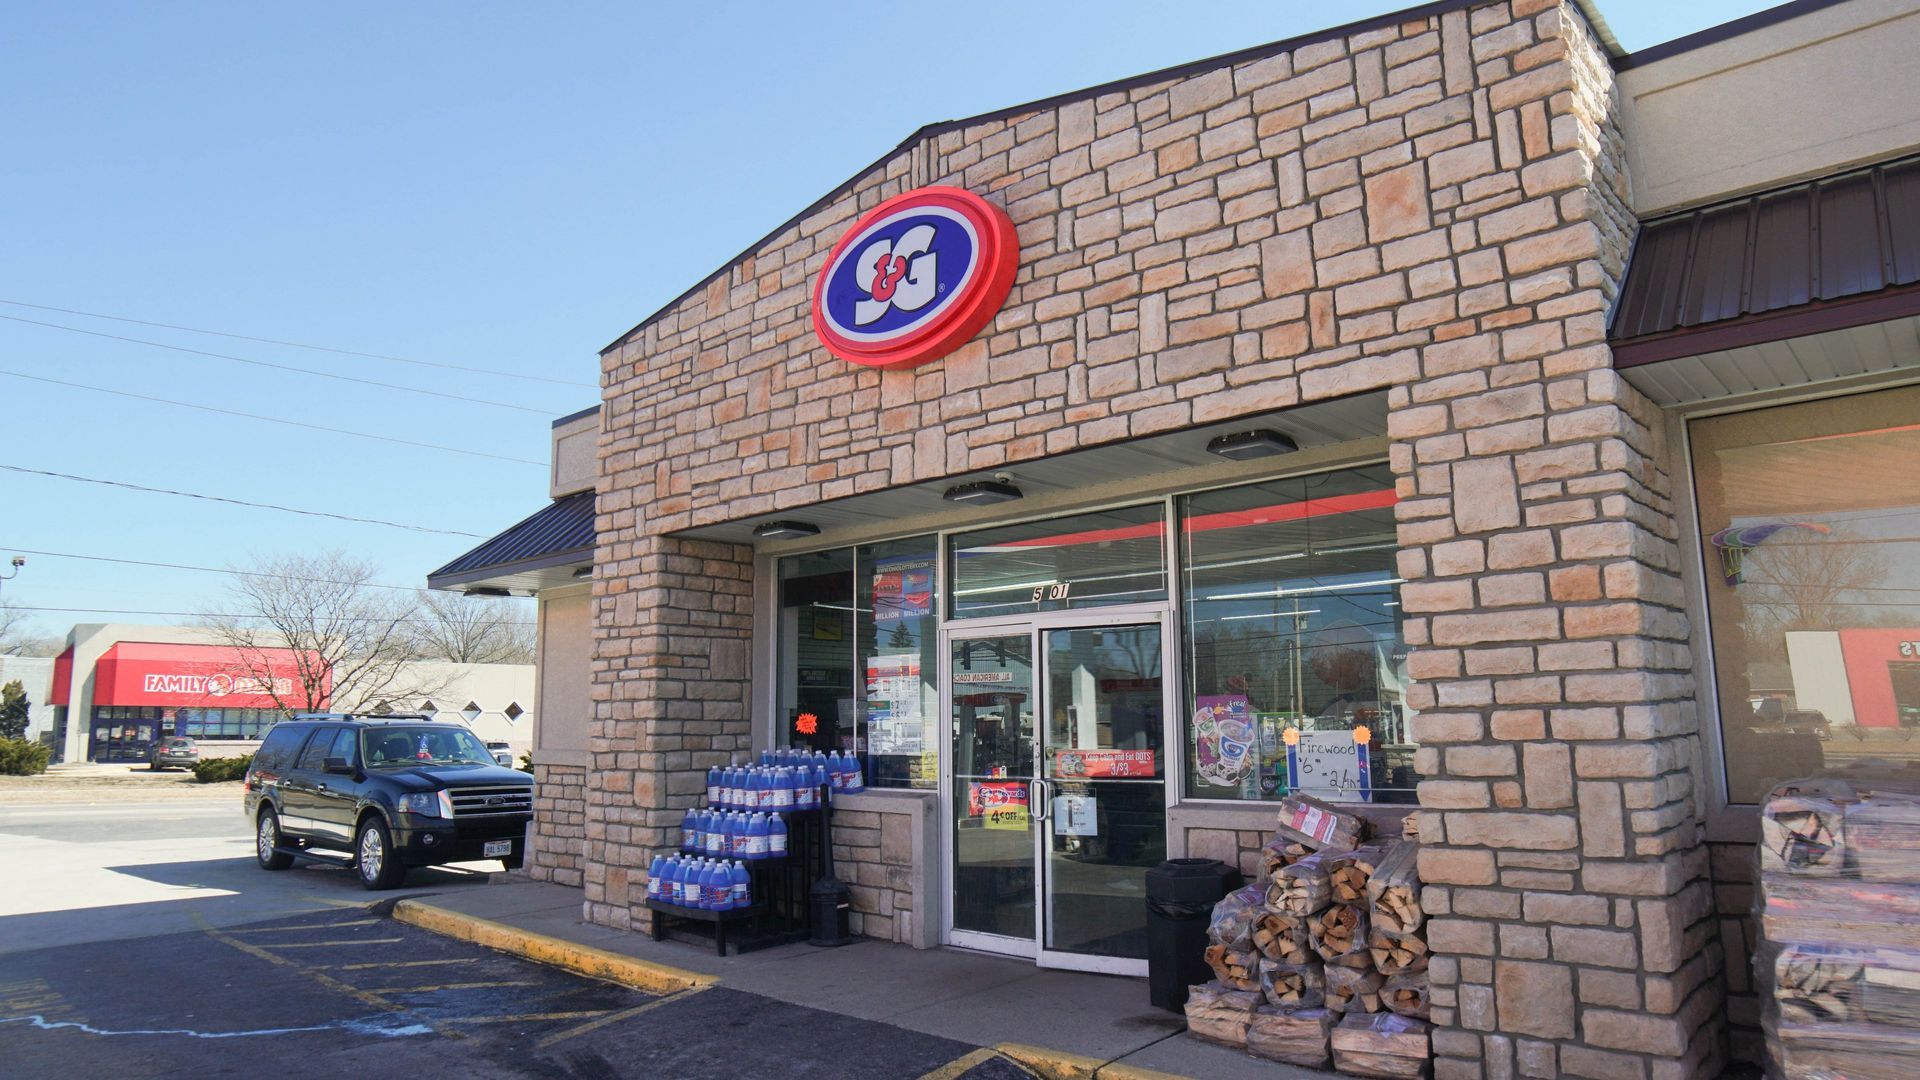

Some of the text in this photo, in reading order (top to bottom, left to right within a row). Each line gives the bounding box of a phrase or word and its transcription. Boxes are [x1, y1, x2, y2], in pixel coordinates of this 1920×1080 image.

[855, 225, 937, 326] S&G
[904, 608, 930, 617] MILLION
[144, 674, 209, 693] FAMILY
[1299, 735, 1356, 755] Firewood
[1085, 752, 1151, 763] Keep Calm and Eat DOTS
[1110, 763, 1129, 776] 3/$3
[1006, 811, 1017, 821] OFF
